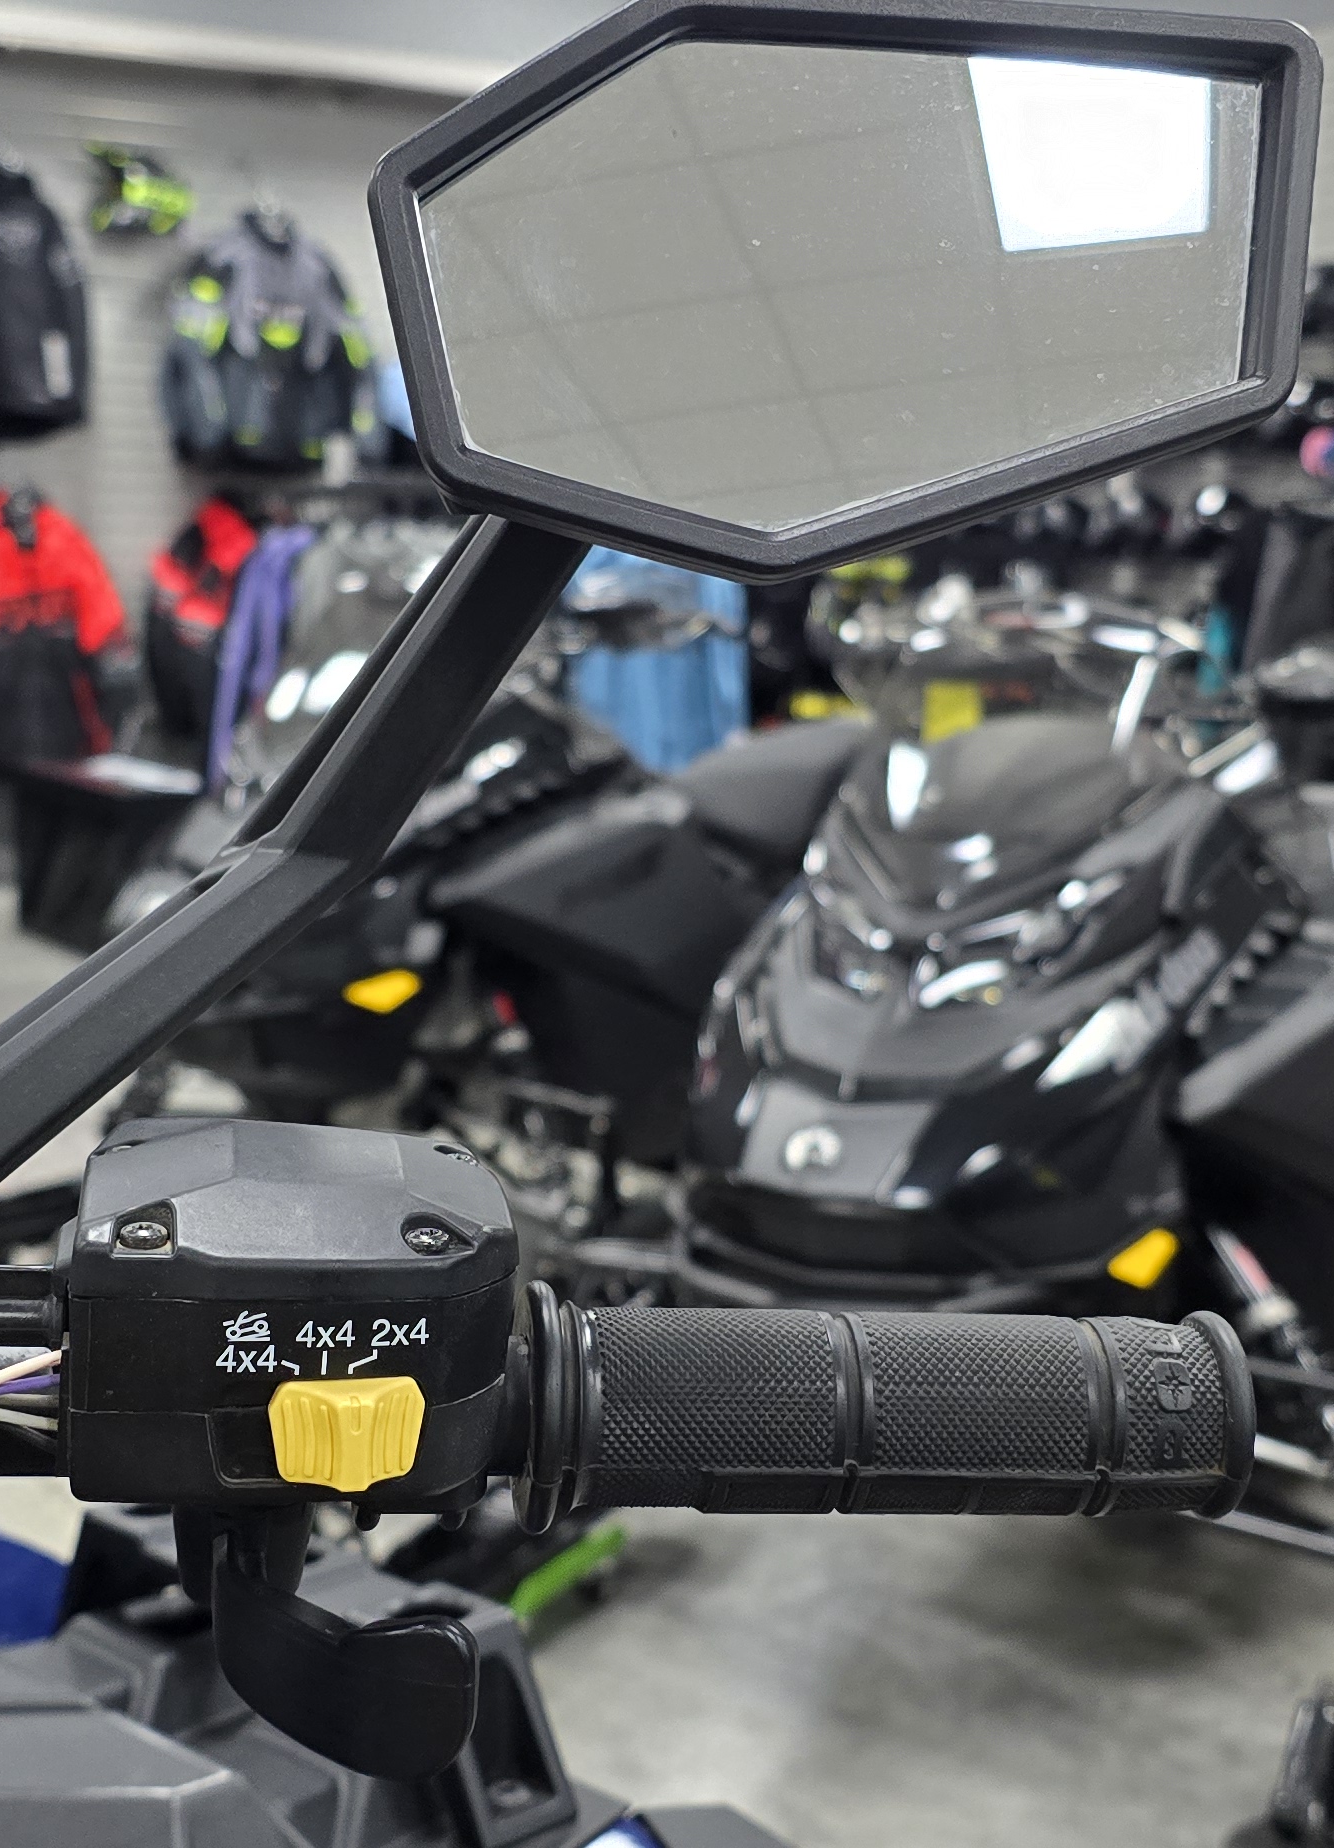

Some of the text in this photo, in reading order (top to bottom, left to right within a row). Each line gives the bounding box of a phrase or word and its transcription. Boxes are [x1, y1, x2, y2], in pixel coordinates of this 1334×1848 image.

[295, 1319, 356, 1348] 4x4
[370, 1317, 430, 1347] 2x4
[215, 1344, 278, 1373] 4x4
